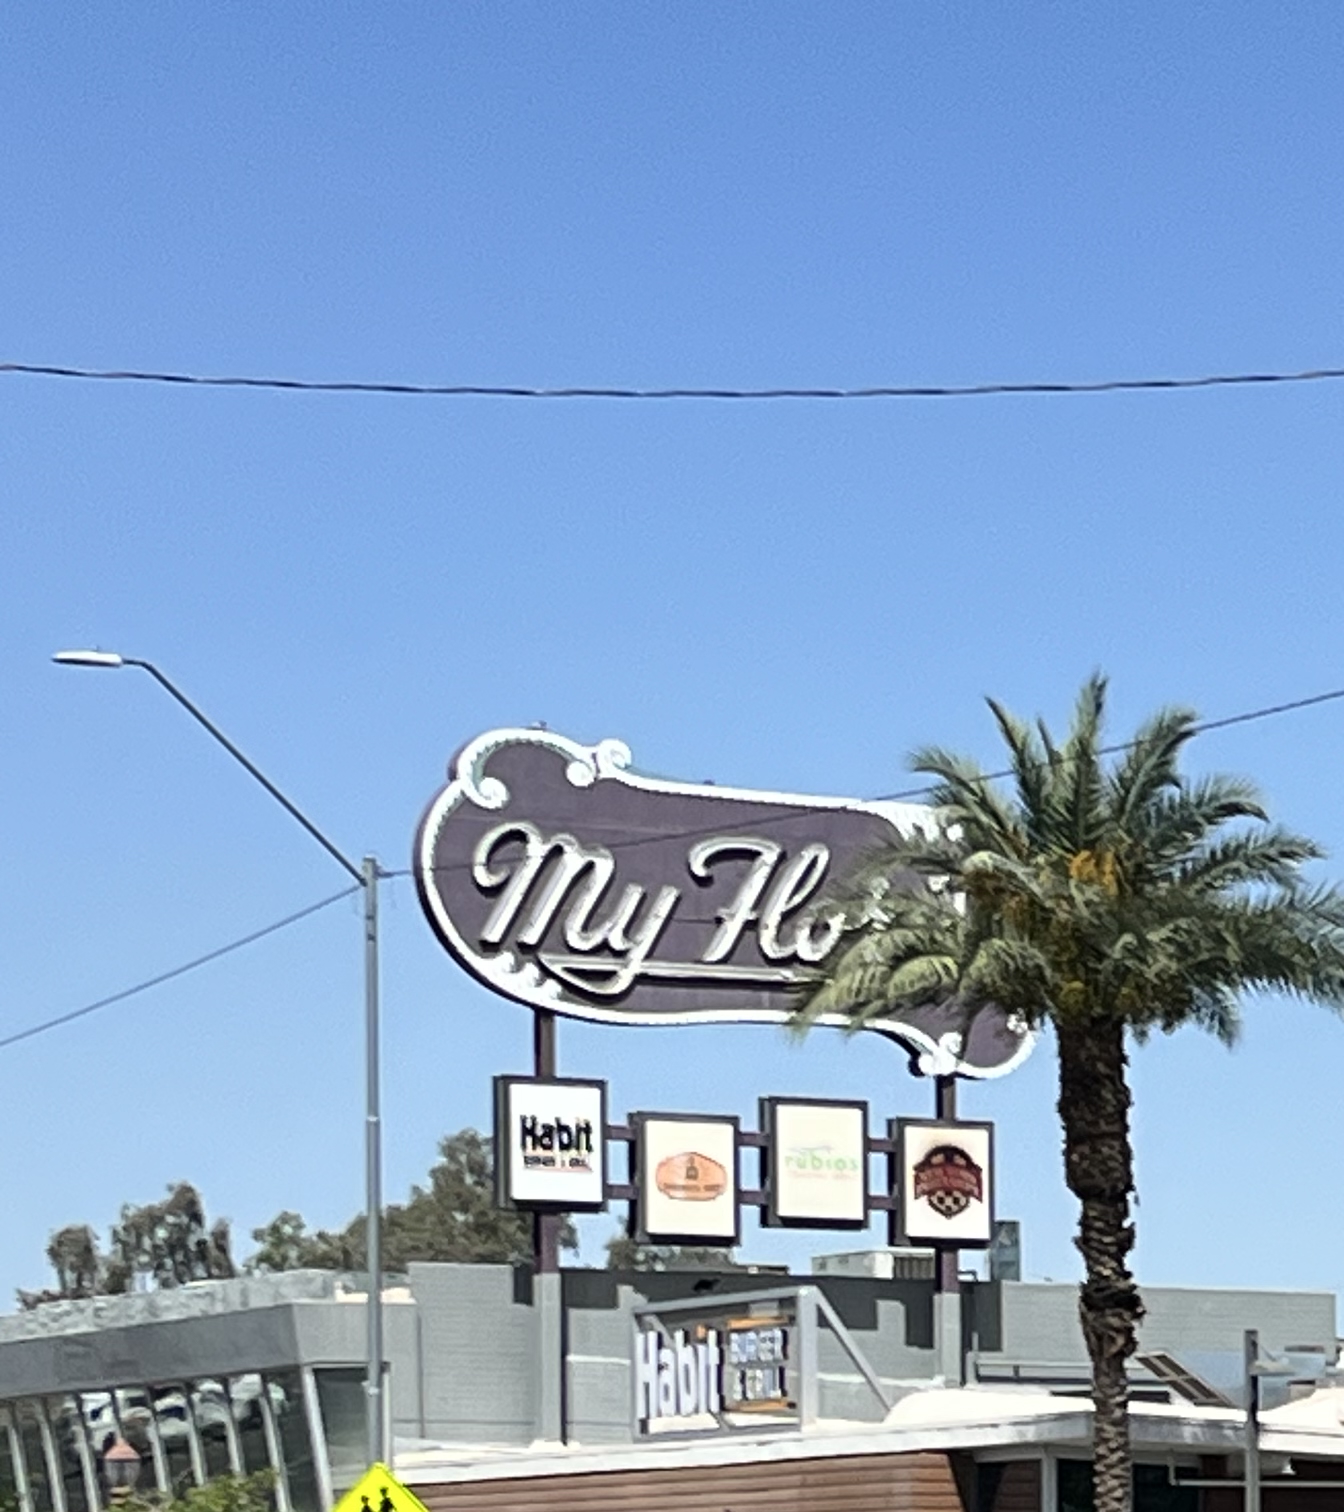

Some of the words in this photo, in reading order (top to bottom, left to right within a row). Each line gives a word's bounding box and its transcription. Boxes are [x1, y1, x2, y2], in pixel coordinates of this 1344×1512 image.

[473, 821, 682, 998] My
[520, 1114, 593, 1153] Habit
[636, 1324, 721, 1419] Habit
